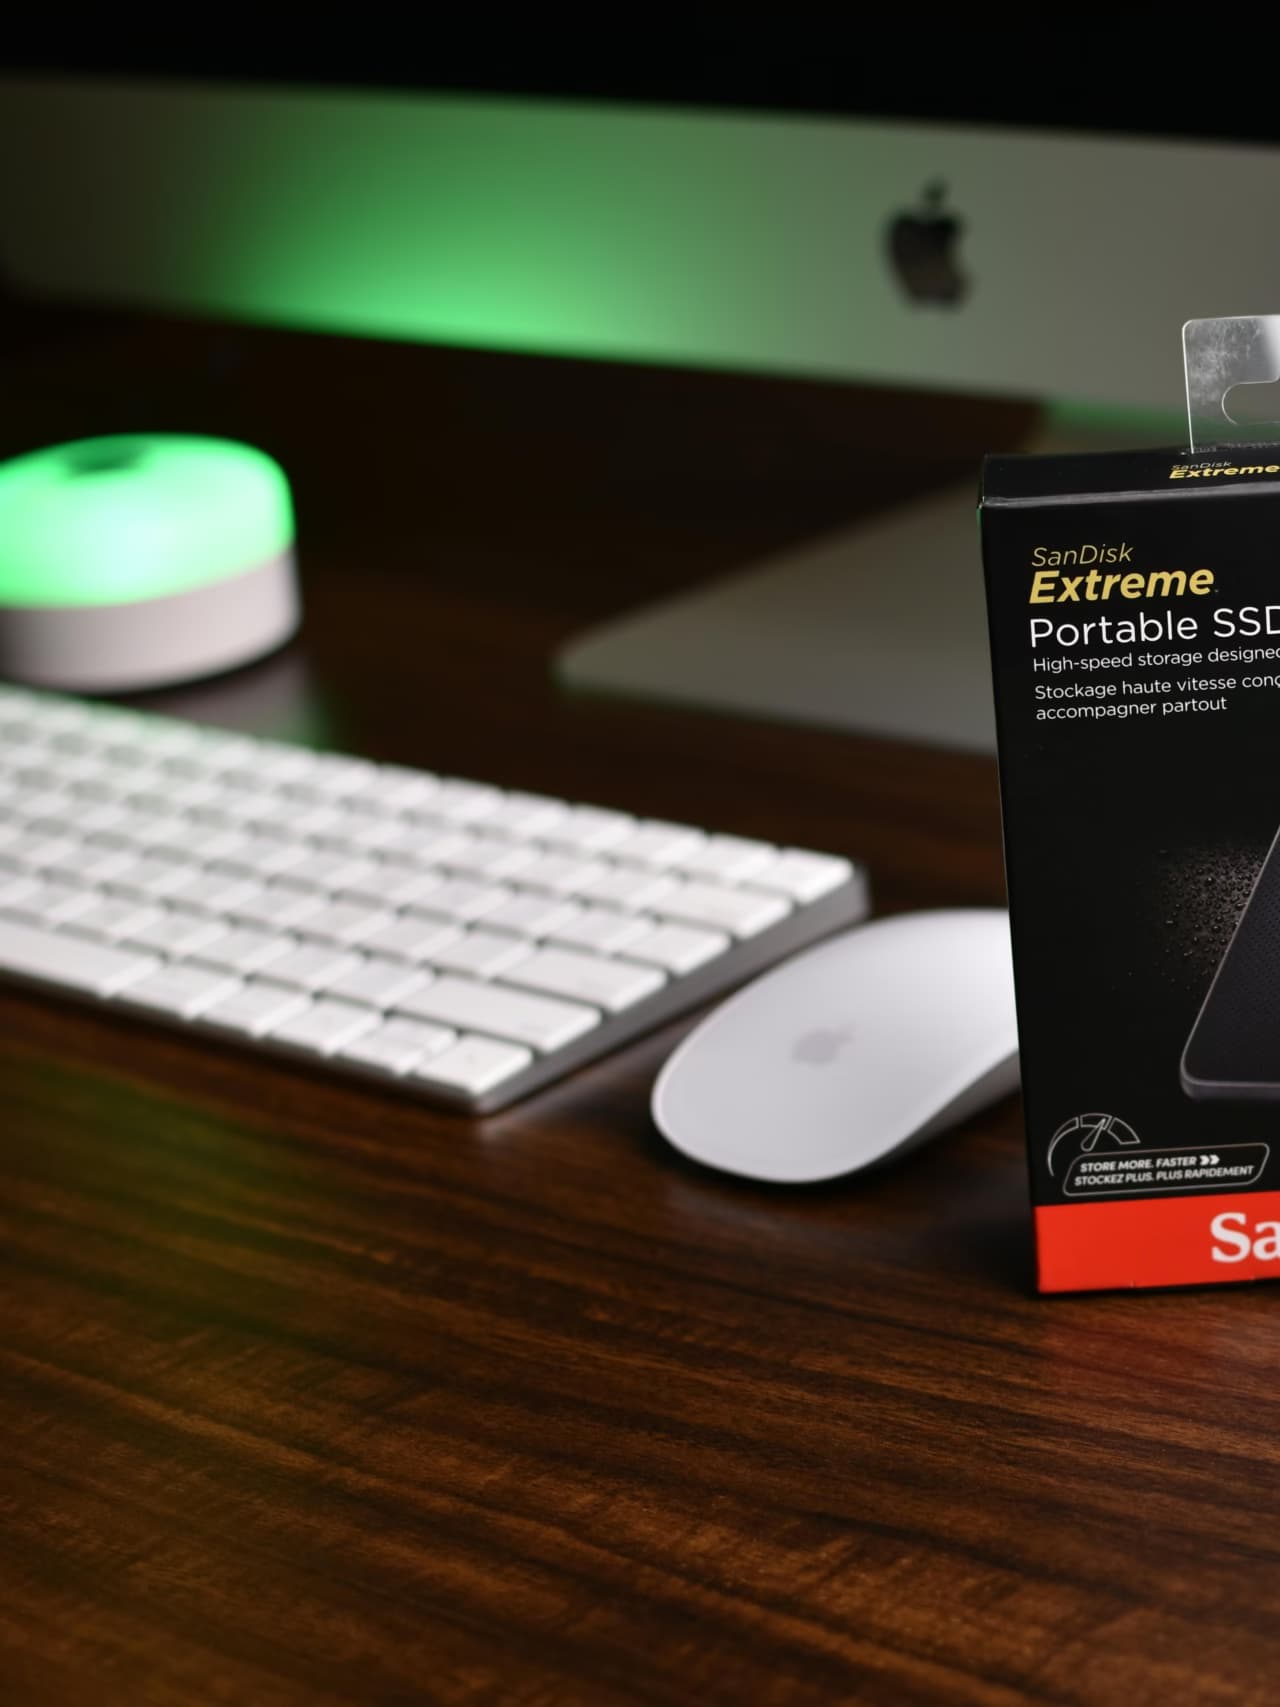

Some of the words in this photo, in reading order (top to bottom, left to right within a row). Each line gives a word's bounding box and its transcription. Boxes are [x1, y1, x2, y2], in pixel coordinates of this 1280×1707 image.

[1169, 464, 1280, 479] Extreme
[1172, 461, 1232, 471] SanDisk
[1031, 543, 1133, 567] SanDisk
[1029, 568, 1215, 604] Extreme
[1029, 610, 1199, 648] Portable
[1033, 652, 1133, 674] High-speed
[1137, 652, 1203, 666] storage
[1035, 682, 1118, 699] Stockage
[1122, 679, 1172, 695] haute
[1176, 676, 1237, 692] vitesse
[1036, 702, 1157, 720] accompagner
[1162, 696, 1228, 716] partout
[1074, 1173, 1124, 1187] STOCKEZ
[1156, 1169, 1184, 1181] PLUS
[1184, 1164, 1254, 1179] RAPIDEMENT
[1080, 1160, 1116, 1173] STORE
[1118, 1158, 1154, 1170] MORE.
[1156, 1156, 1197, 1169] FASTER
